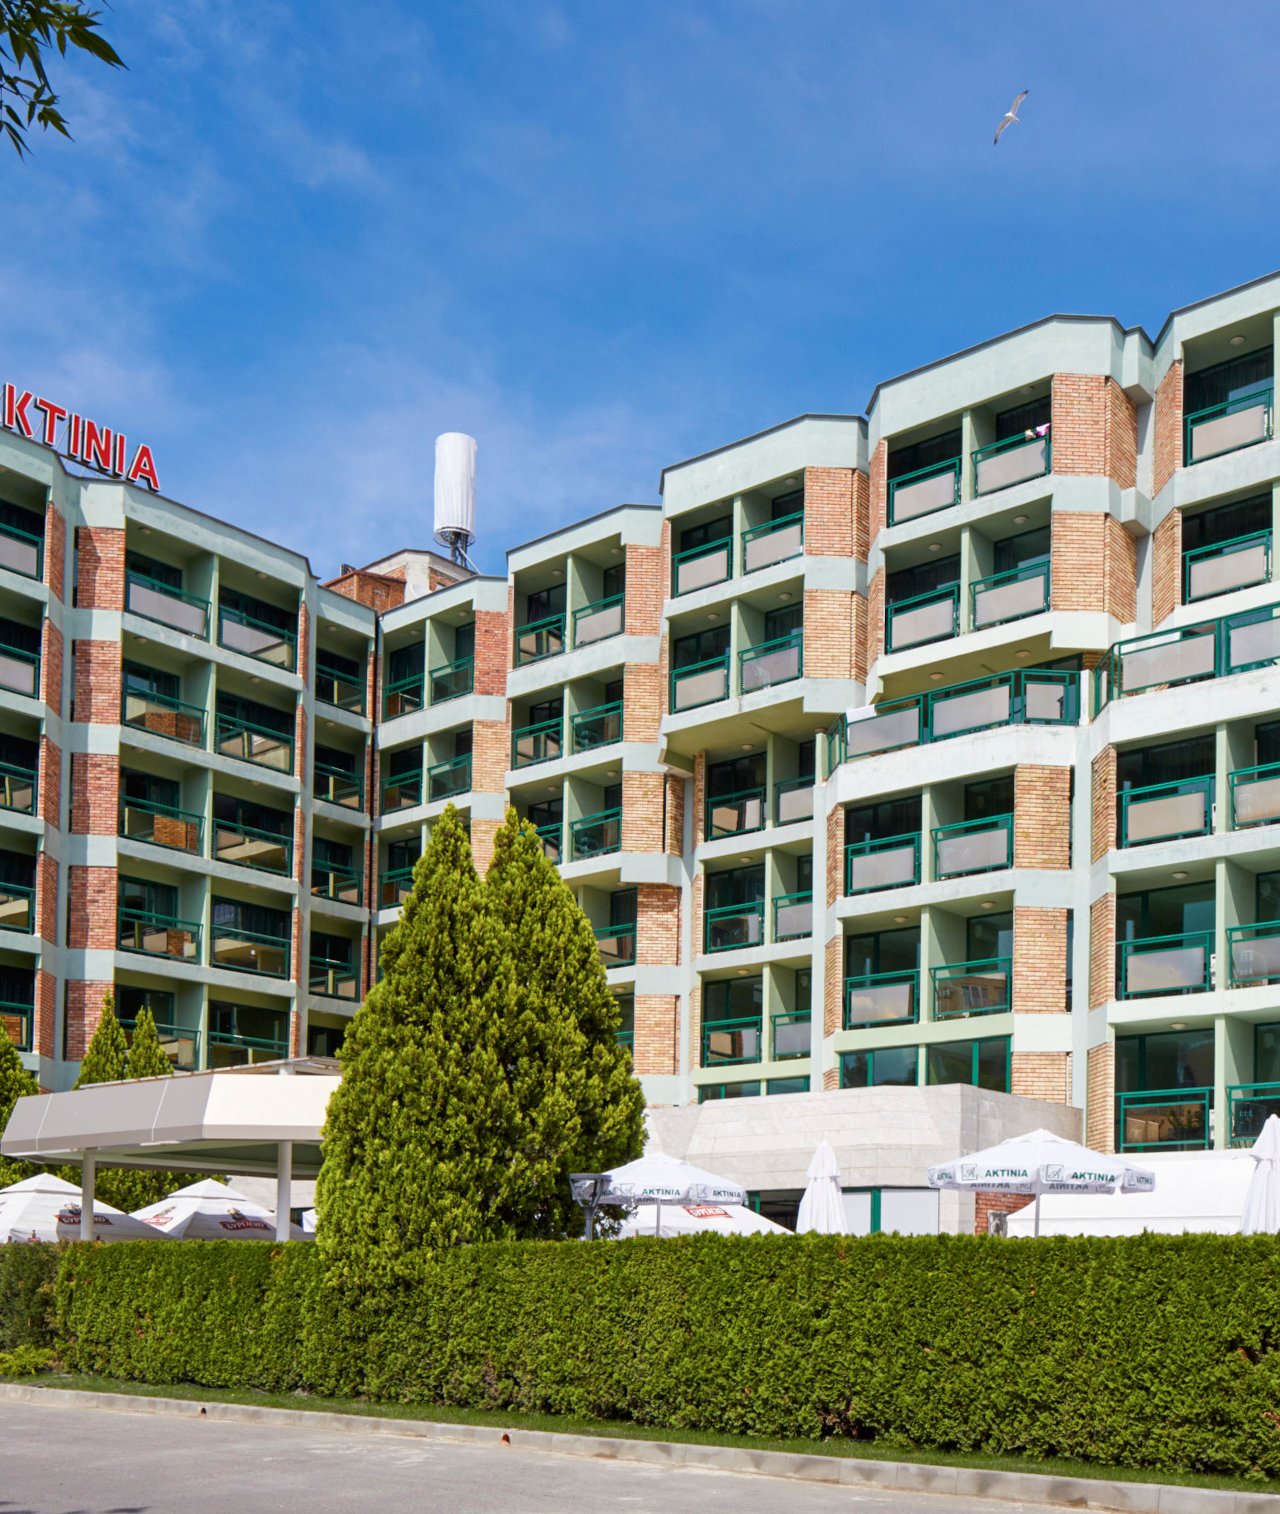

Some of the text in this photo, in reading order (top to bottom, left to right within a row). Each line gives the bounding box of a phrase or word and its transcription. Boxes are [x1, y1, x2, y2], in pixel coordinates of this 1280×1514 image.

[984, 1168, 1029, 1178] AKTINIA
[1071, 1171, 1116, 1183] AKTINIA
[642, 1188, 681, 1196] AKTINIA
[712, 1189, 741, 1198] AKTINIA
